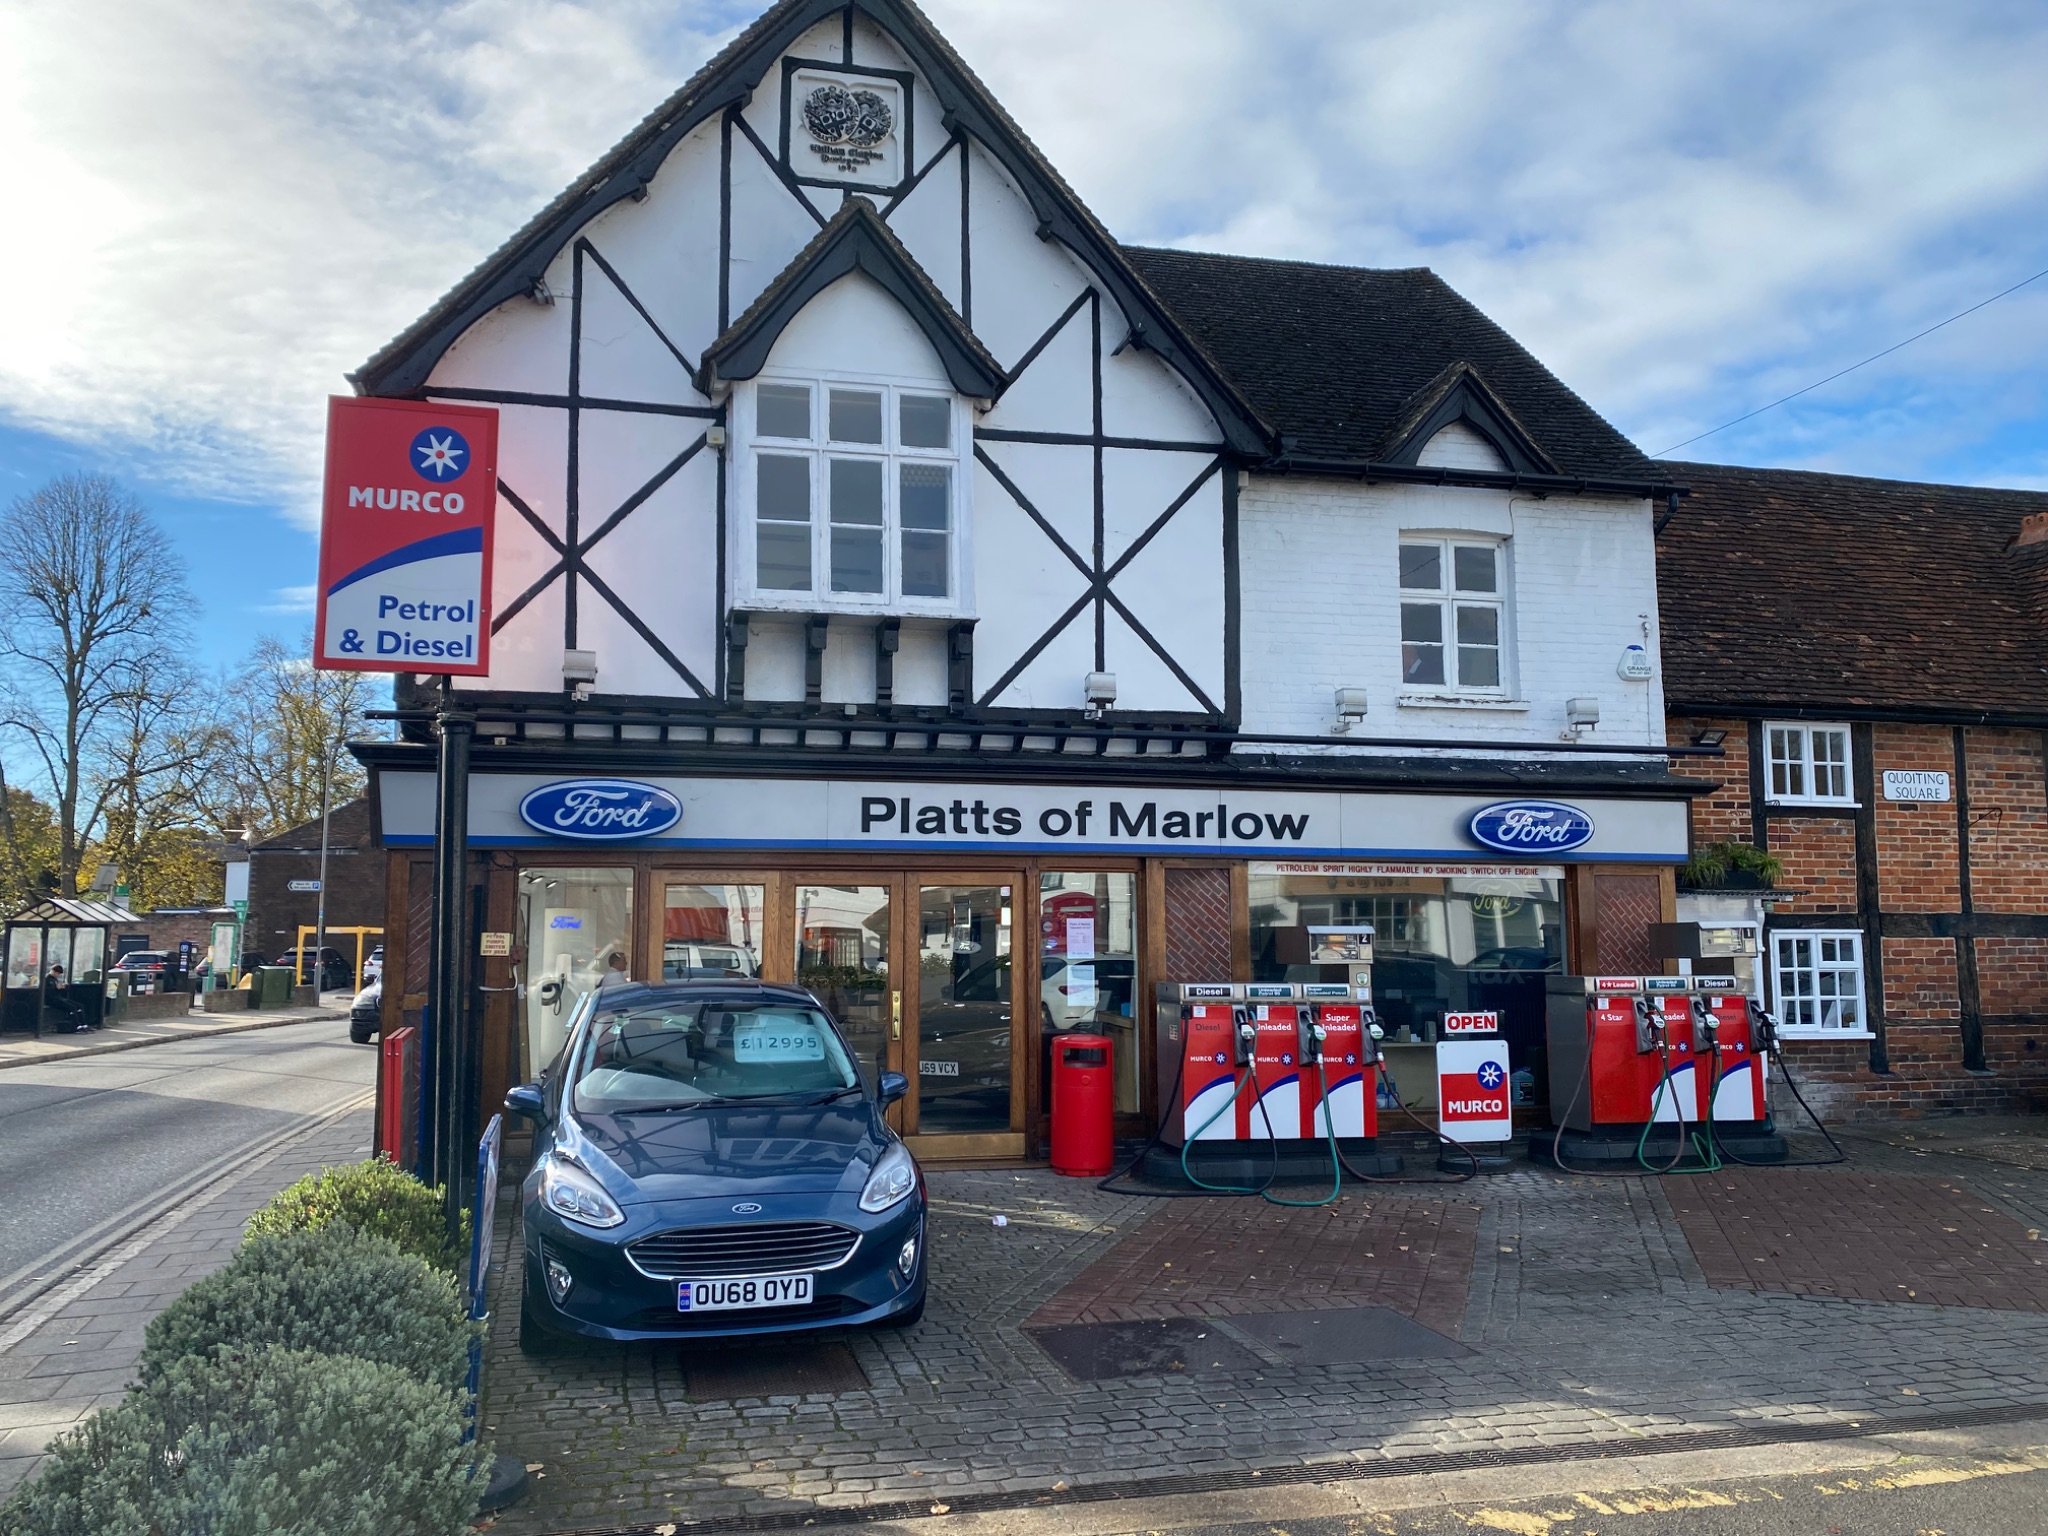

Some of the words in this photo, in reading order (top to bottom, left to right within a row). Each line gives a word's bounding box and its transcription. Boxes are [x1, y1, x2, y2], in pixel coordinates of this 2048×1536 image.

[348, 486, 465, 514] MURCO
[378, 595, 474, 623] Petrol
[339, 628, 365, 653] &
[377, 630, 472, 658] Diesel
[1888, 772, 1944, 785] QUOITING
[1895, 786, 1941, 799] SQUARE
[554, 789, 652, 828] Ford
[860, 796, 1022, 836] Platts
[1039, 800, 1093, 837] of
[1109, 801, 1310, 841] Marlow
[1497, 808, 1572, 843] Ford
[1276, 863, 1319, 873] PETROLEUM
[1323, 864, 1345, 873] SPIRIT
[1348, 864, 1373, 874] HIGHLY
[1376, 865, 1419, 875] FLAMMABLE
[1423, 866, 1433, 875] NO
[1436, 866, 1467, 875] SMOKING
[1470, 866, 1497, 876] SWITCH
[1499, 867, 1511, 876] OFF
[1514, 867, 1539, 876] ENGINE
[1473, 884, 1511, 910] Ford
[1361, 934, 1368, 943] 2
[1704, 979, 1728, 987] Diesel
[1196, 987, 1223, 996] Diesel
[1325, 1013, 1350, 1023] Super
[1447, 1015, 1496, 1030] OPEN
[1607, 1013, 1623, 1021] Star
[1195, 1023, 1221, 1031] Diesel
[741, 1037, 817, 1049] £12995
[938, 1063, 956, 1074] VCX
[1448, 1099, 1502, 1114] MURCO
[695, 1282, 757, 1305] OU68
[764, 1278, 808, 1301] OYD
